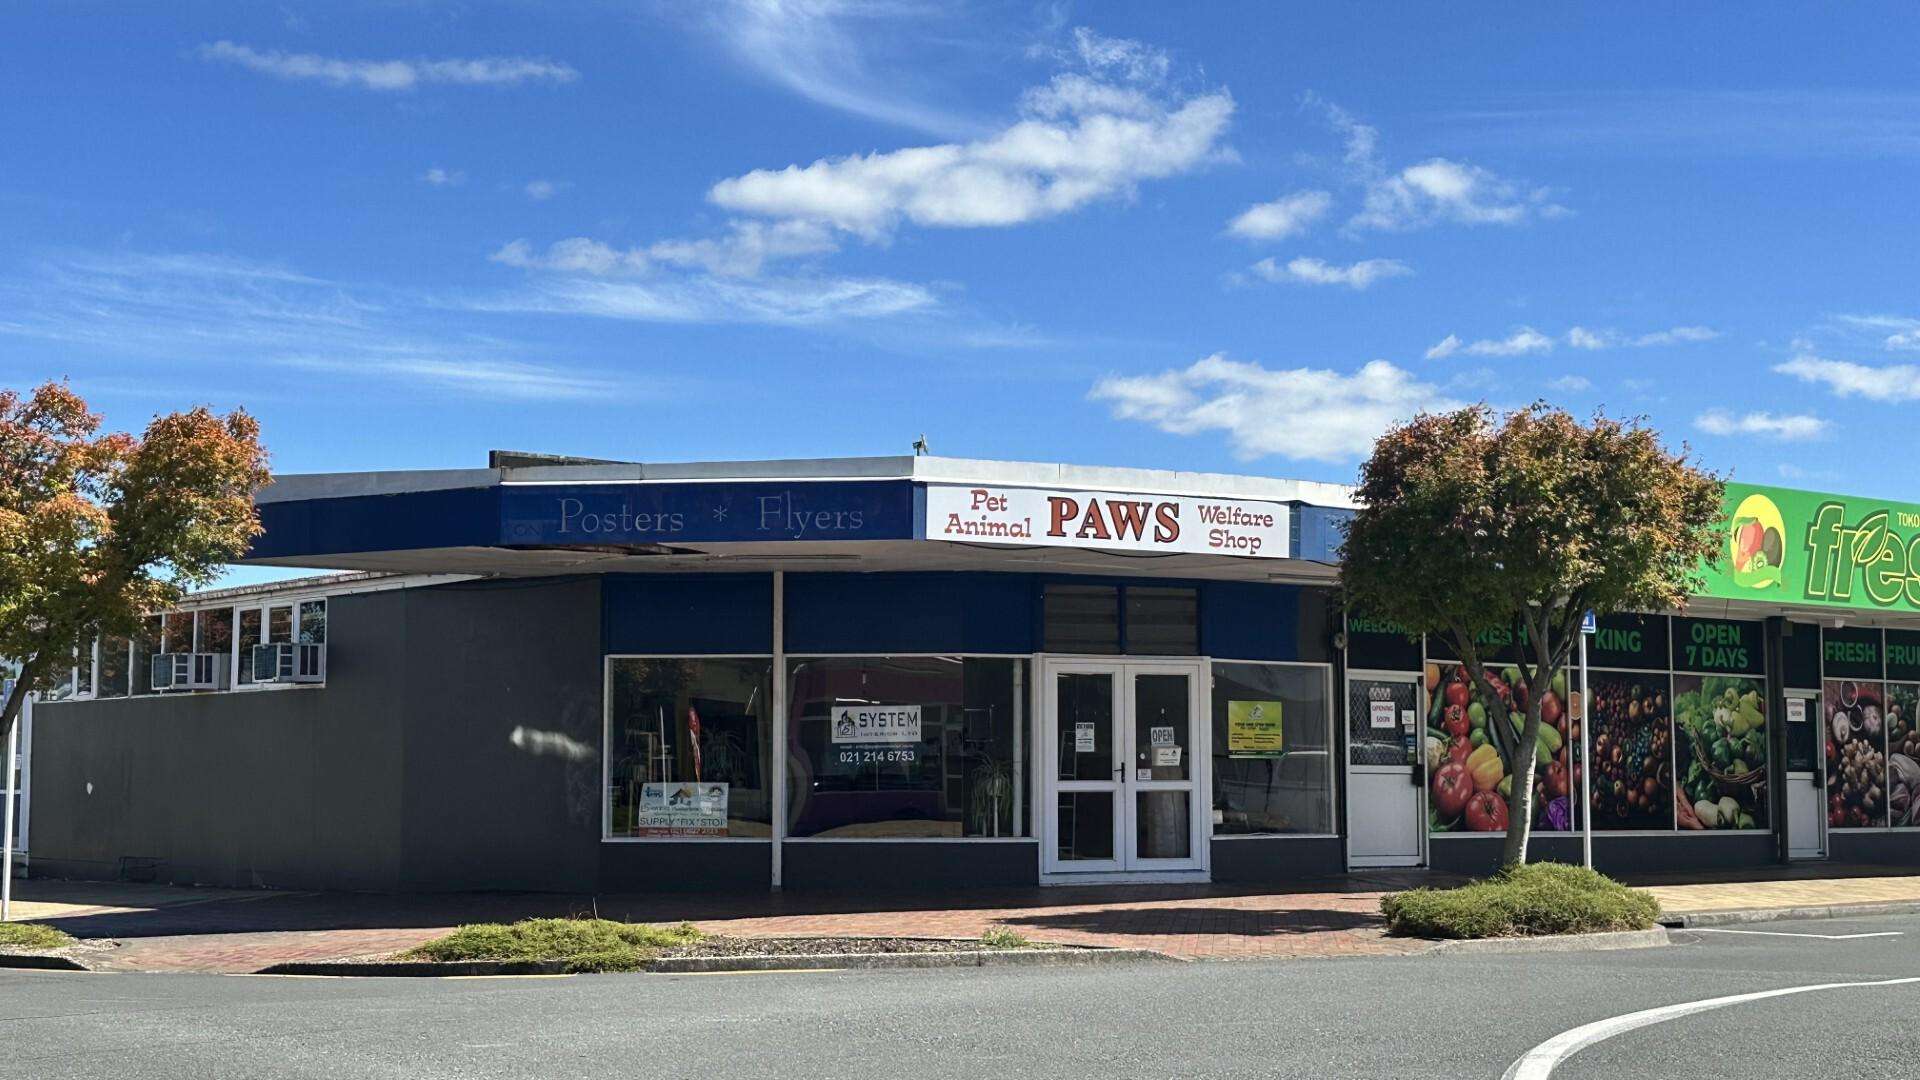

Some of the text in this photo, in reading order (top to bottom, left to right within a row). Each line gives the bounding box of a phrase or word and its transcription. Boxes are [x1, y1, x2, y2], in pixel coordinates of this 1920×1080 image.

[970, 489, 1008, 512] Pet
[556, 490, 864, 540] Posters Flyers
[944, 513, 1032, 538] Animal
[1046, 496, 1181, 543] PAWS
[1198, 504, 1274, 528] Welfare
[1208, 528, 1262, 555] Shop
[1595, 627, 1642, 653] KING
[1691, 622, 1741, 645] OPEN
[1686, 645, 1749, 669] 7 DAYS
[1824, 641, 1876, 664] FRESH
[859, 711, 918, 728] SYSTEM
[1152, 729, 1174, 743] OPEN
[840, 750, 915, 763] 021 214 6753
